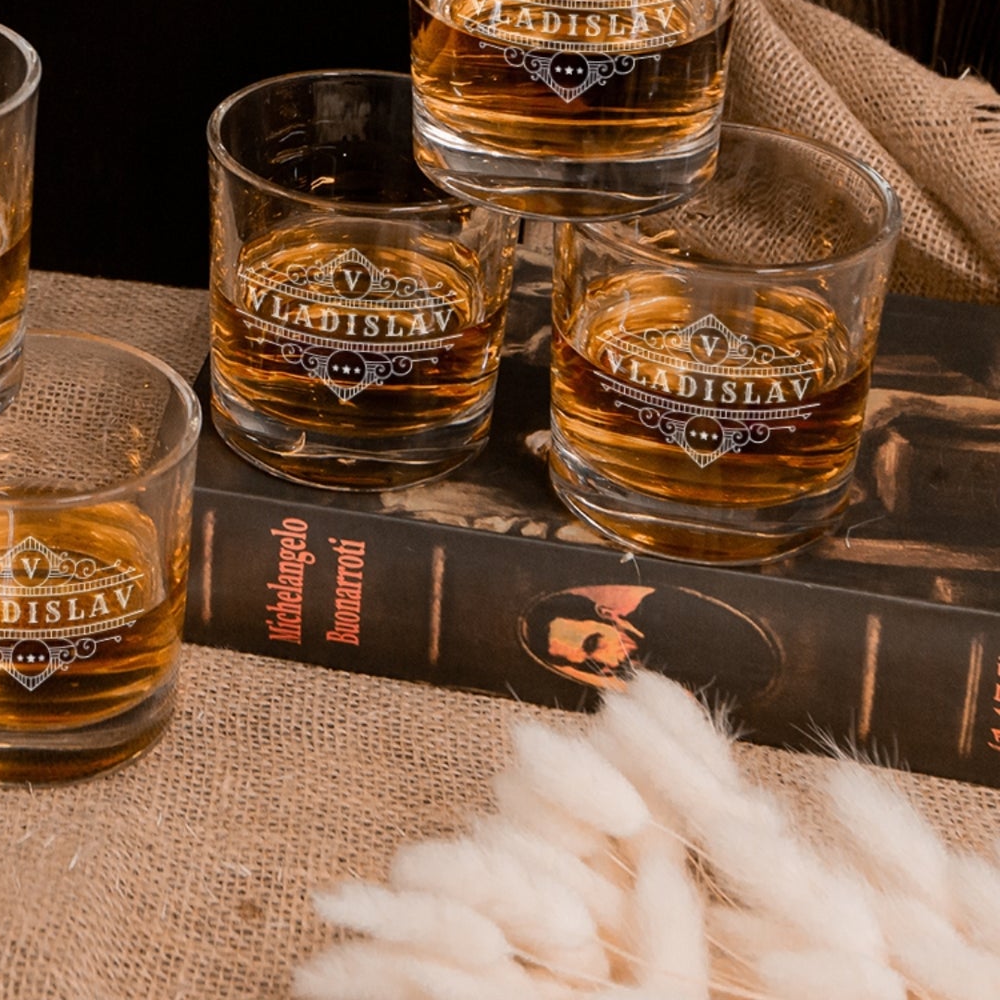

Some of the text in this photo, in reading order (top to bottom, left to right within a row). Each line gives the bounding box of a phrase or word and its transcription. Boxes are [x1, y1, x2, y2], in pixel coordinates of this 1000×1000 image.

[343, 269, 362, 291] V
[248, 286, 454, 337] VLADISLAV
[700, 336, 720, 357] V
[605, 347, 812, 404] VLADISLAV
[21, 558, 40, 580] V
[265, 517, 316, 644] Michelangelo
[326, 538, 365, 646] Buonarroti
